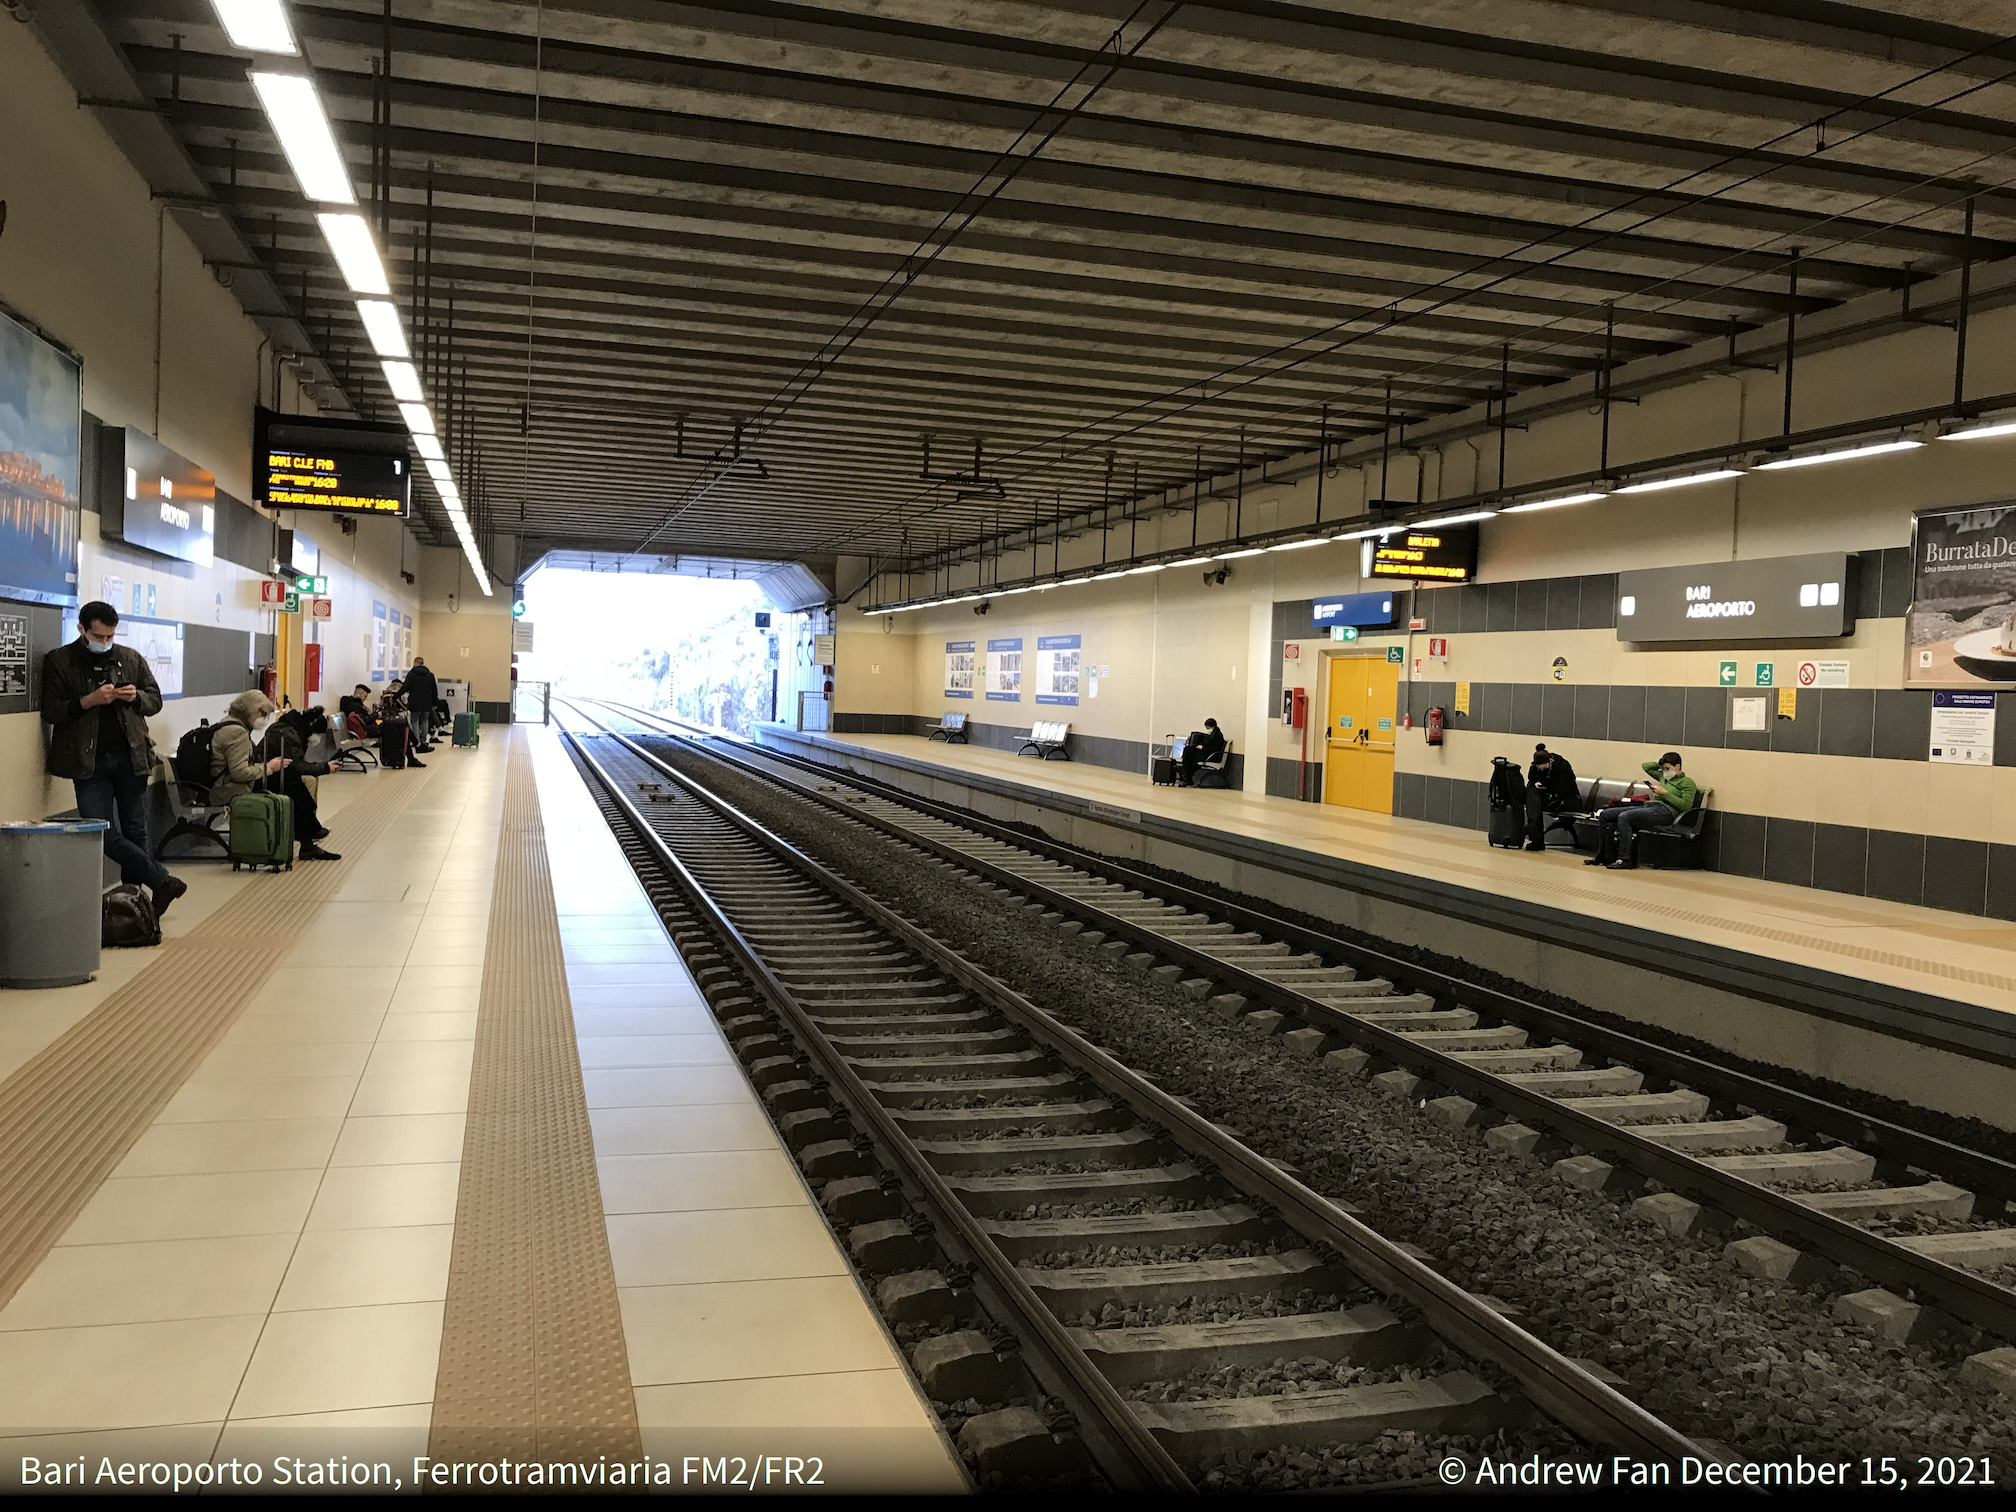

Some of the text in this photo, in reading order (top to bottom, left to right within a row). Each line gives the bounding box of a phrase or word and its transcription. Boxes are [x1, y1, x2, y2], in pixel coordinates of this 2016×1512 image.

[269, 455, 291, 467] BARI
[393, 460, 402, 475] 1
[313, 476, 337, 488] 16:20
[375, 499, 399, 511] 16:00
[1926, 536, 2016, 563] BurrataDe
[1937, 563, 1967, 573] tradizione
[1967, 562, 1983, 570] tutta
[1983, 561, 1992, 569] da
[1992, 560, 2016, 570] gustare
[1686, 585, 1711, 601] BARI
[1686, 600, 1756, 618] AEROPORTO
